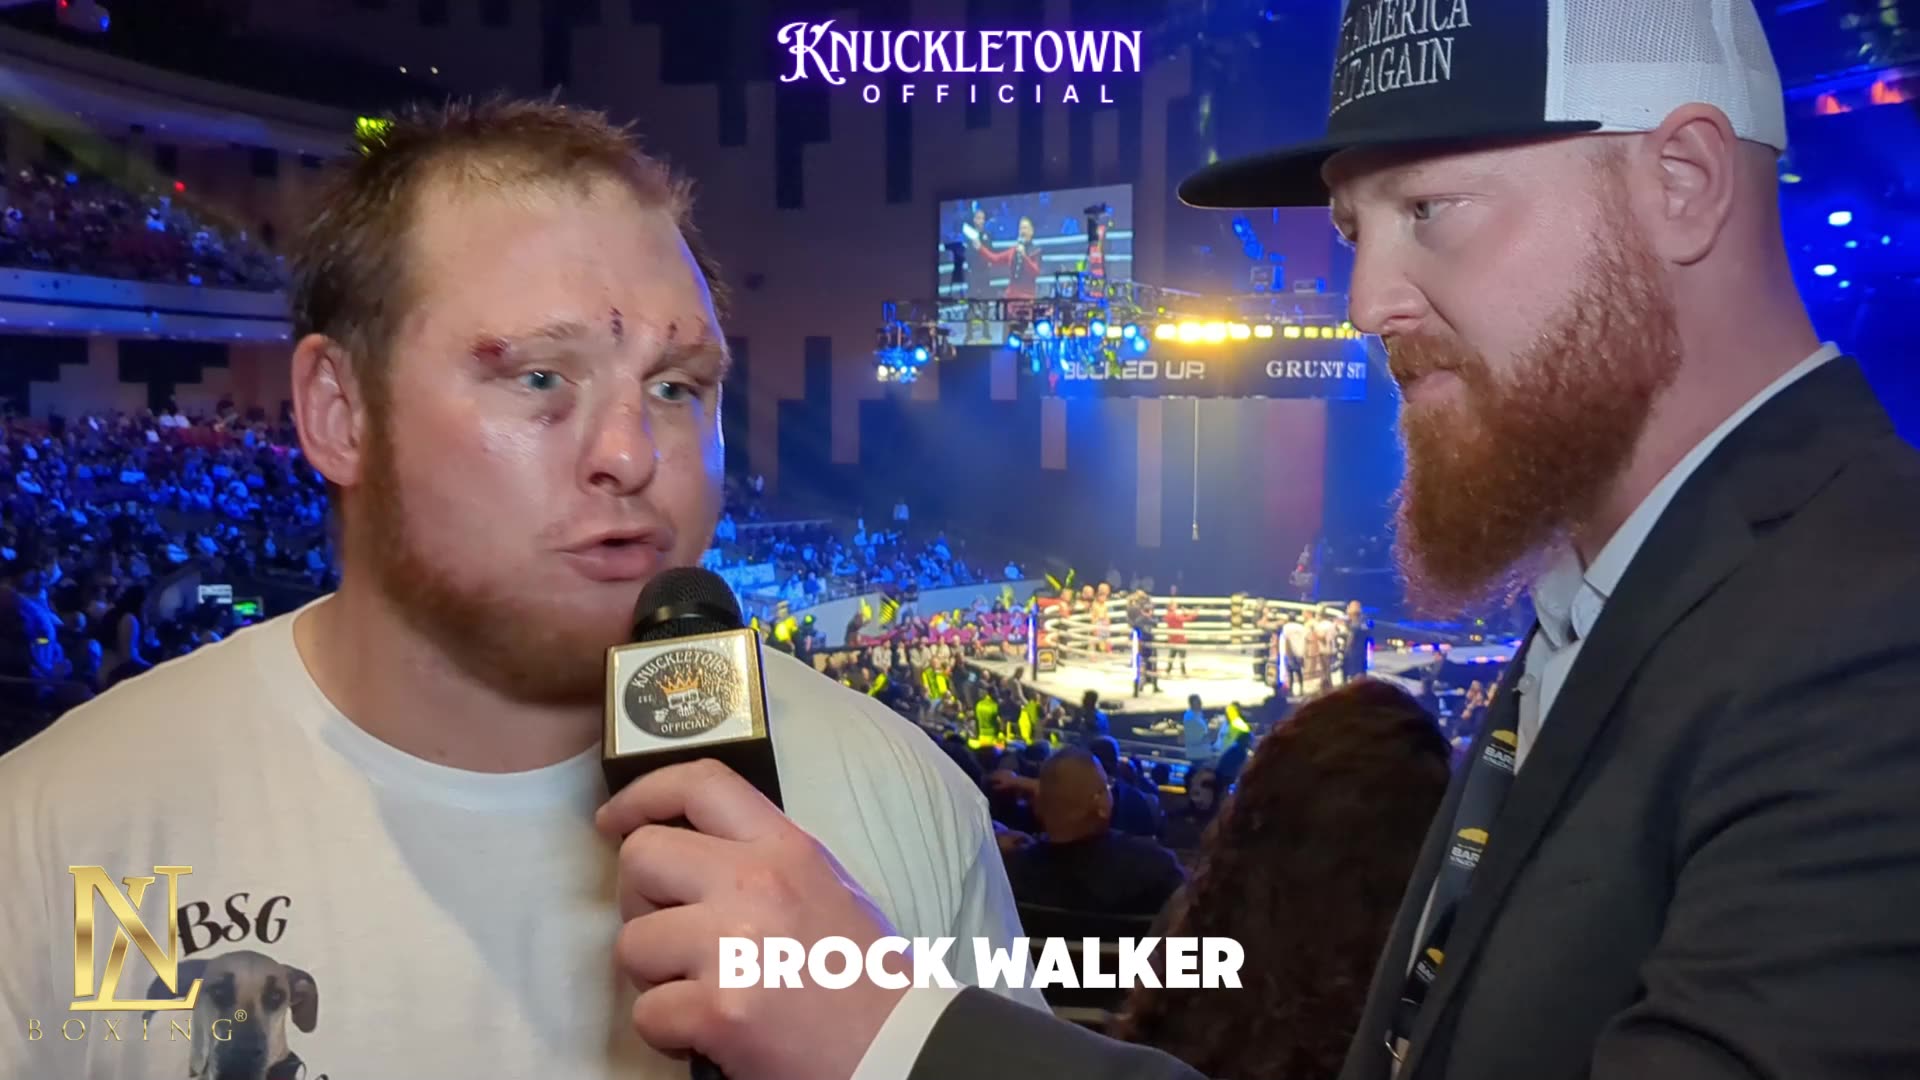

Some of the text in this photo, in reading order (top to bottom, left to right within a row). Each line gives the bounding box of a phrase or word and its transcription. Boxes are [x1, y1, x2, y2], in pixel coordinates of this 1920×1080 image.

[1355, 37, 1455, 100] AGAIN
[1265, 359, 1344, 379] GRUNT
[176, 892, 292, 957] BSG
